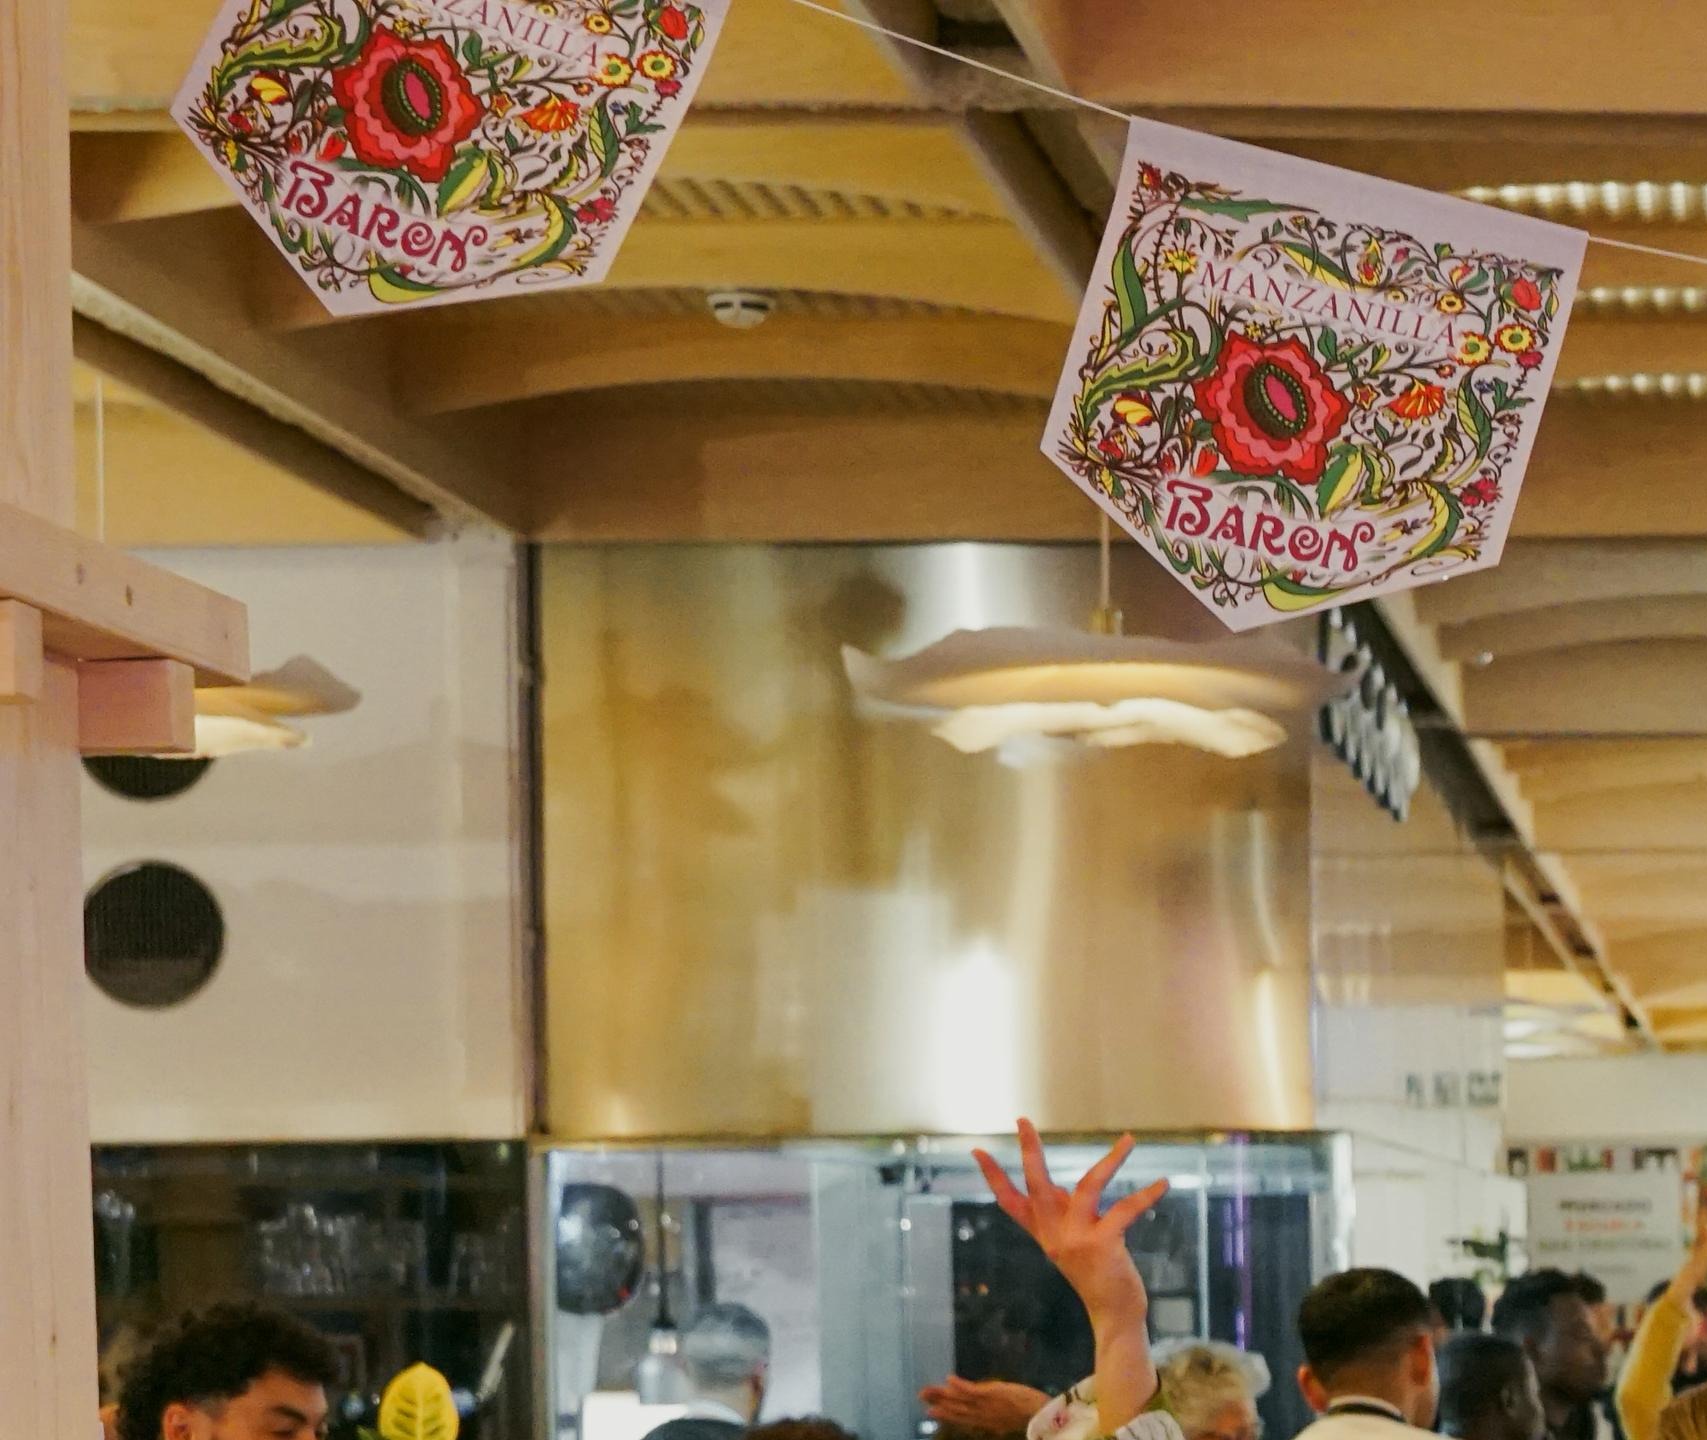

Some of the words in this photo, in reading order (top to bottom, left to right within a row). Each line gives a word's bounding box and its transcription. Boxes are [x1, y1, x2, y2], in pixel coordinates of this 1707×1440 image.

[430, 0, 598, 67] ZANILLA
[281, 160, 488, 273] BARON
[1198, 260, 1458, 347] MANZANILLA
[1163, 480, 1375, 572] BARON
